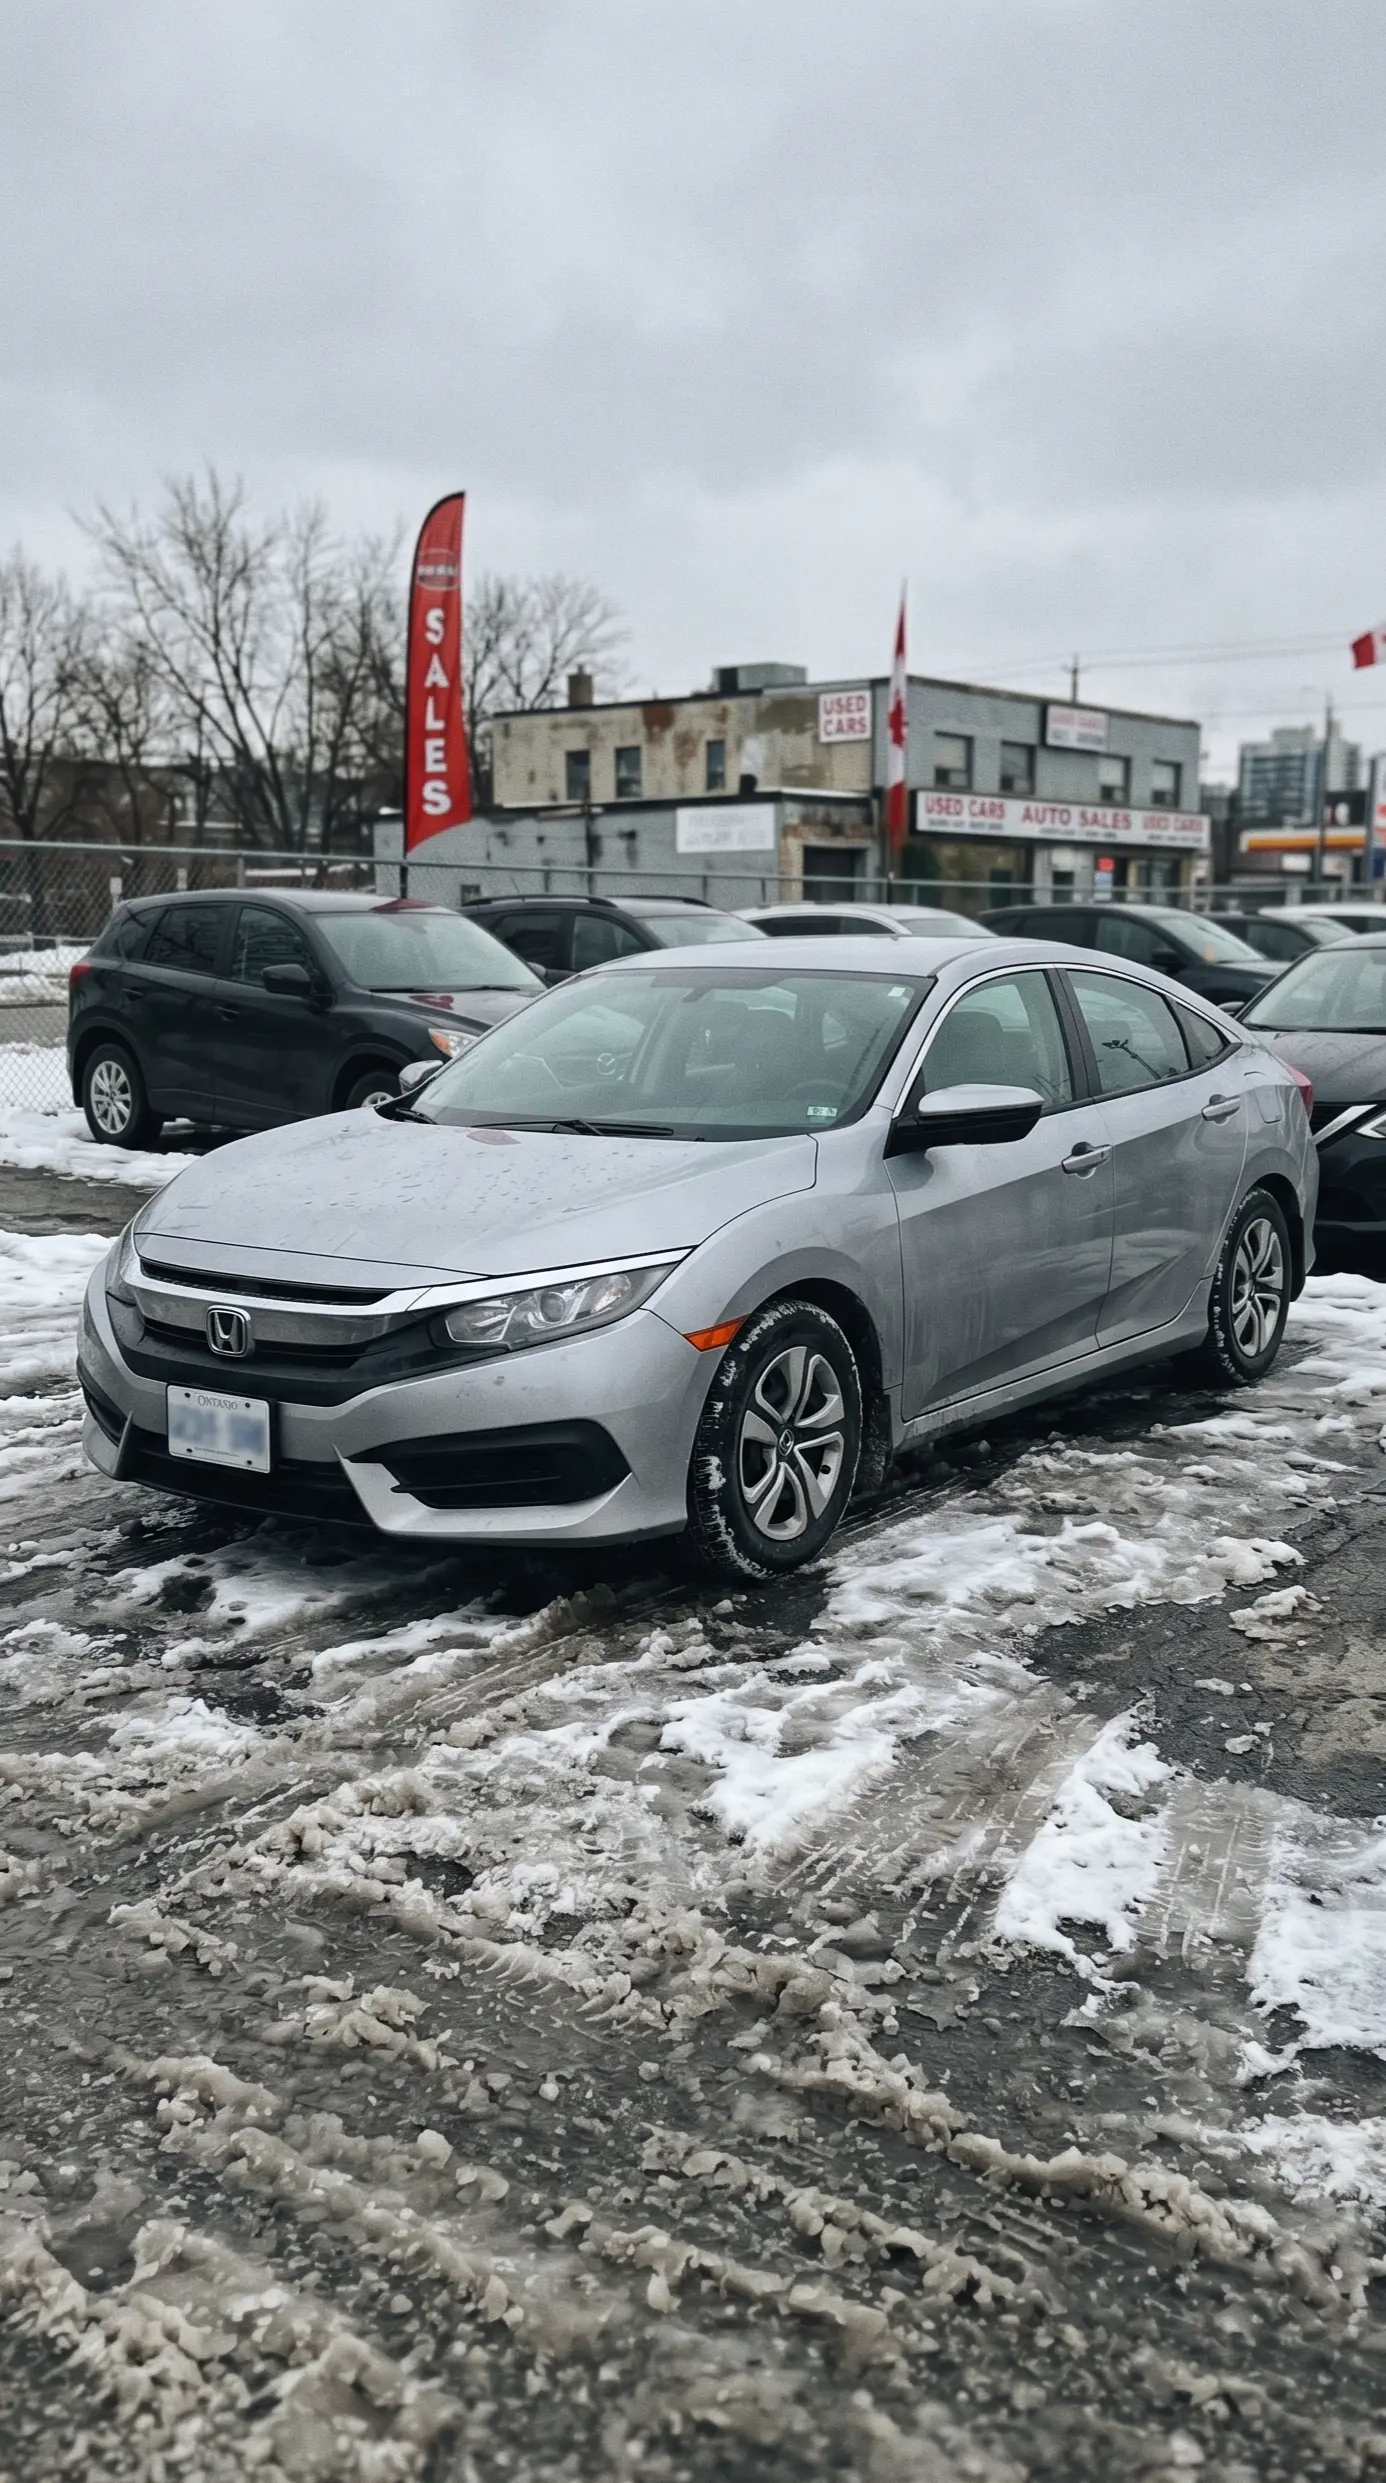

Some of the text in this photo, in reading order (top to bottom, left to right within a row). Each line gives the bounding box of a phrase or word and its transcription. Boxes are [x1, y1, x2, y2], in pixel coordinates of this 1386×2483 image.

[422, 607, 452, 816] SALES
[824, 695, 867, 716] USED
[823, 716, 867, 737] CARS
[925, 795, 963, 816] USED
[968, 799, 1005, 819] CARS
[1020, 804, 1071, 826] AUTO
[1080, 809, 1132, 830] SALES
